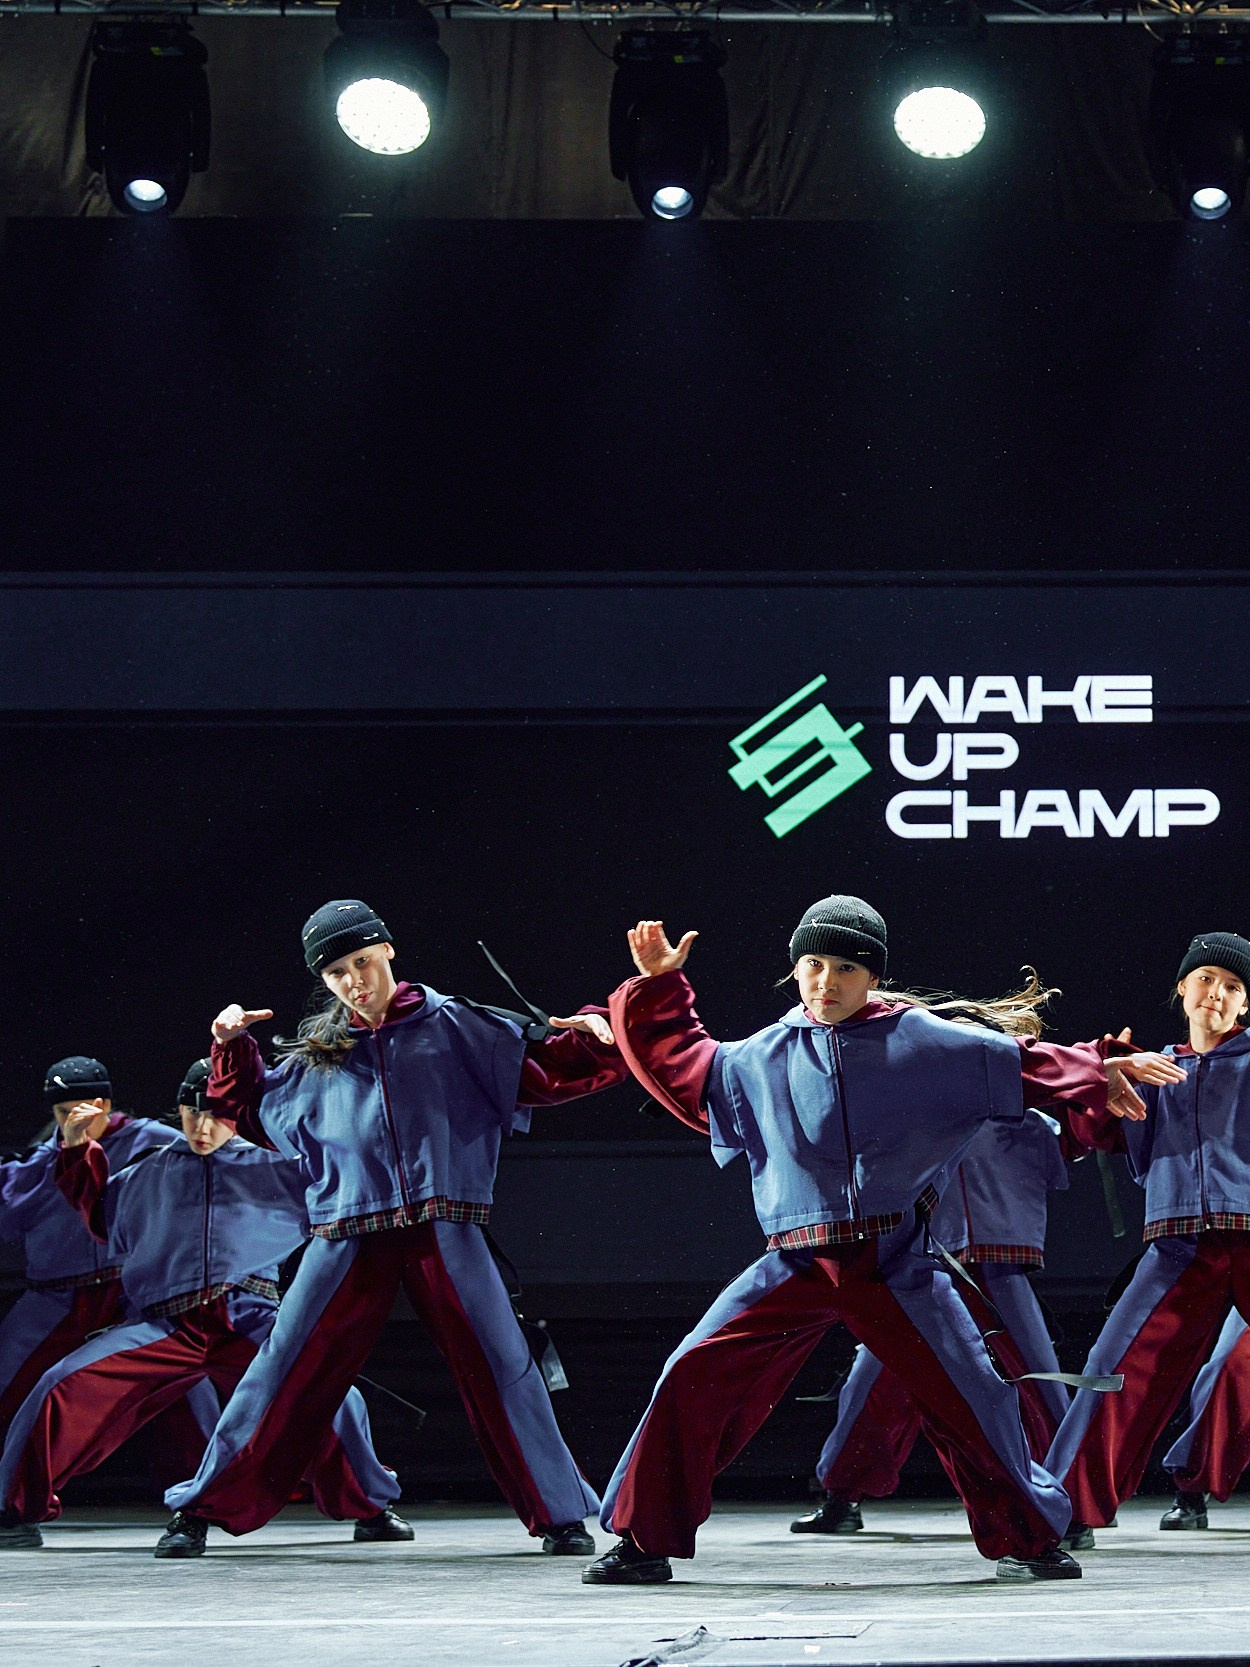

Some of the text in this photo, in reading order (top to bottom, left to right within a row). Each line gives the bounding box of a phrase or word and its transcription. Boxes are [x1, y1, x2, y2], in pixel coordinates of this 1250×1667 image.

[889, 674, 1154, 724] WAKE
[889, 732, 1020, 781] UP
[885, 788, 1221, 839] CHAMP
